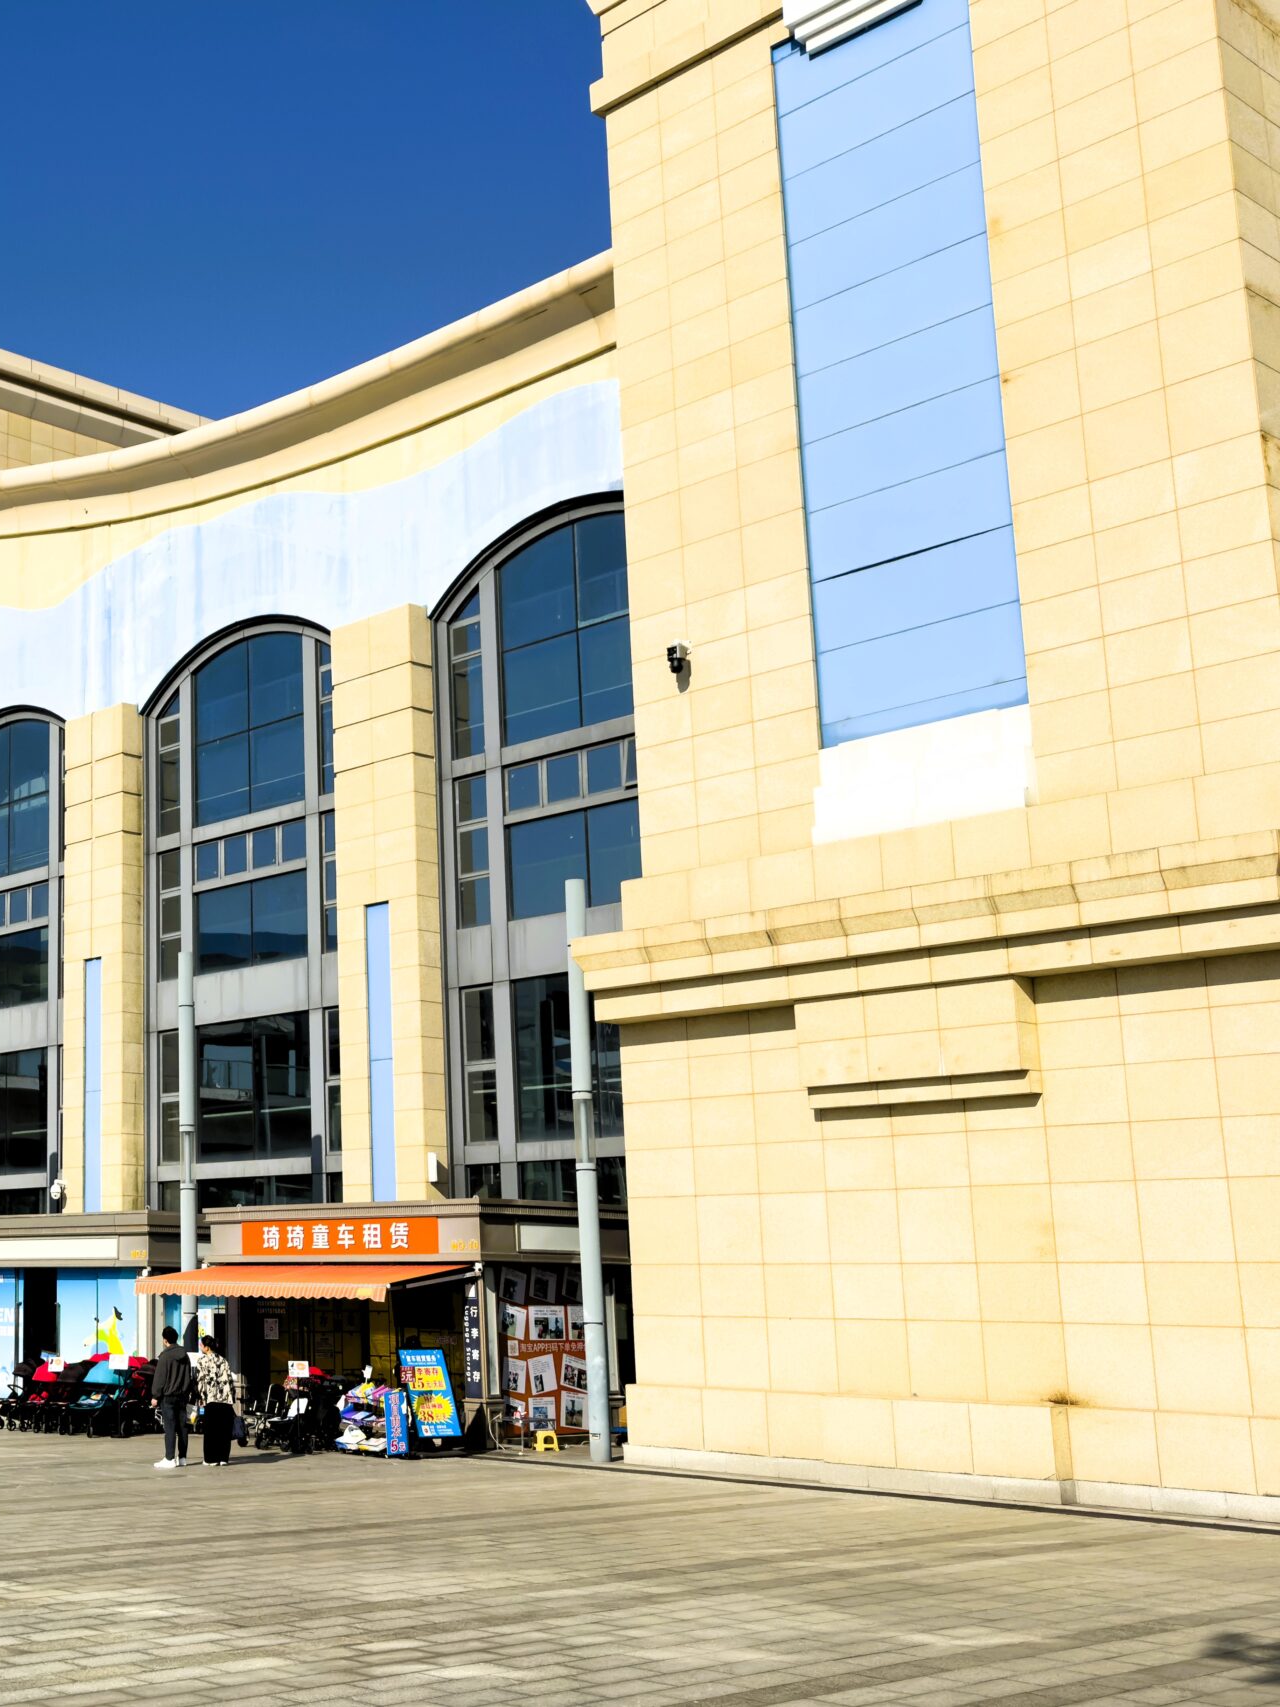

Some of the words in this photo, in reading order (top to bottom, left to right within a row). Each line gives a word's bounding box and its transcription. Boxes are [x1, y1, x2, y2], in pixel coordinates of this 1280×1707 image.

[263, 1222, 409, 1250] 琦琦童车租赁
[470, 1305, 481, 1383] 行李寄存
[520, 1342, 586, 1353] 淘宝APP扫码下单免押
